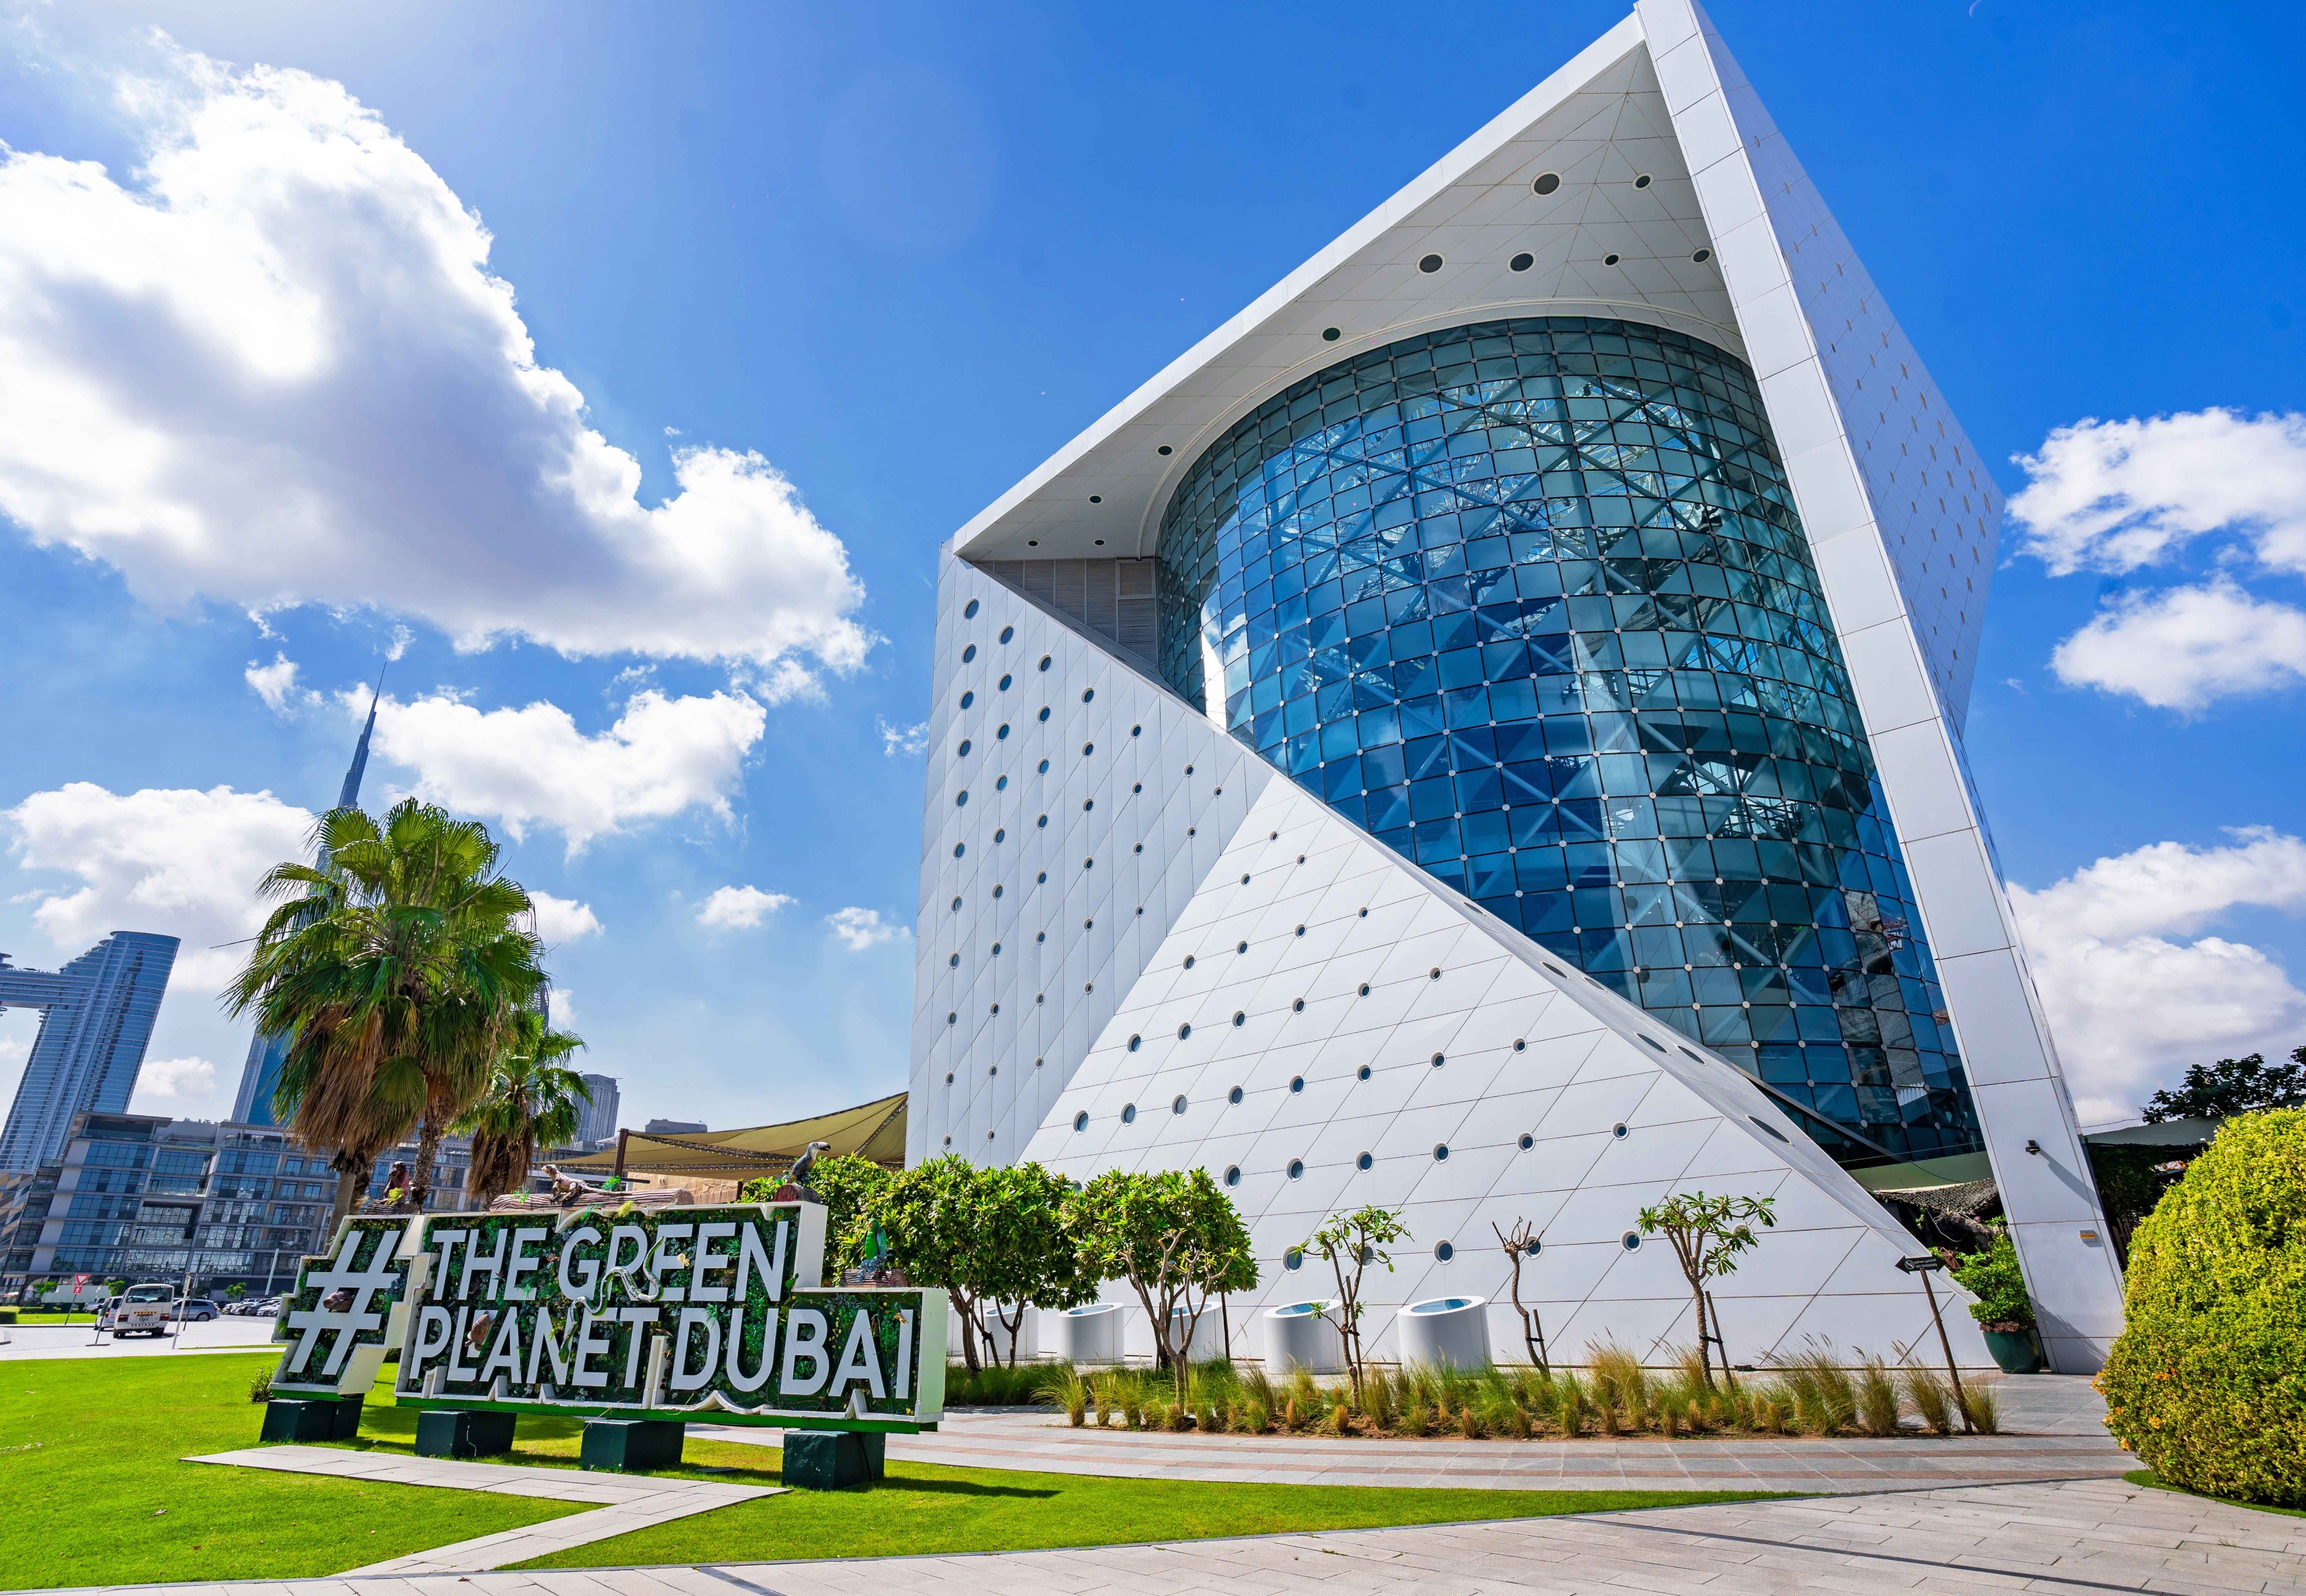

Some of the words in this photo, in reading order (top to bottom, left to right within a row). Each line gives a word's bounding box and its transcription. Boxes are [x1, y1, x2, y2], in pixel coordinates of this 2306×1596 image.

[432, 1227, 548, 1301] THE
[558, 1220, 788, 1302] GREEN
[409, 1306, 659, 1388] PLANET
[670, 1307, 913, 1399] DUBAI
